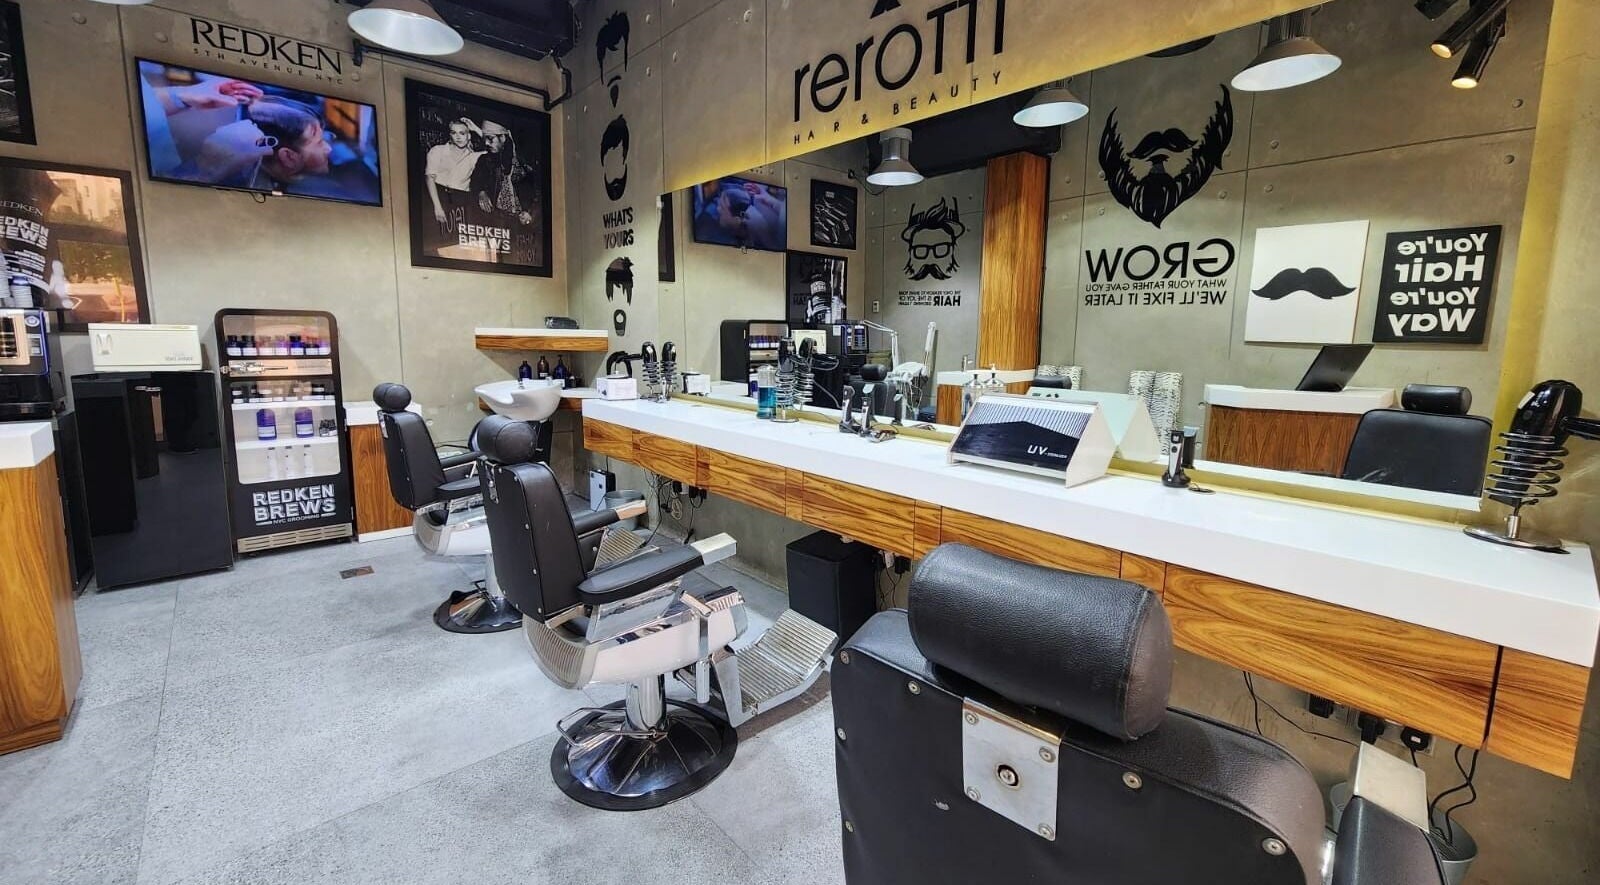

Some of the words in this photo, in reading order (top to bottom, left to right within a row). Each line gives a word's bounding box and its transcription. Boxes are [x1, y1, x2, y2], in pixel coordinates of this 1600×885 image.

[191, 18, 342, 75] REDKEN
[240, 58, 303, 76] AVENUE
[315, 75, 343, 85] NYC
[861, 113, 869, 124] &
[893, 70, 1001, 115] BEAUTY
[458, 223, 511, 239] REDKEN
[458, 234, 512, 251] BREWS
[603, 228, 634, 249] YOURS
[1027, 444, 1049, 456] UV
[253, 484, 335, 507] REDKEN
[254, 498, 337, 521] BREWS
